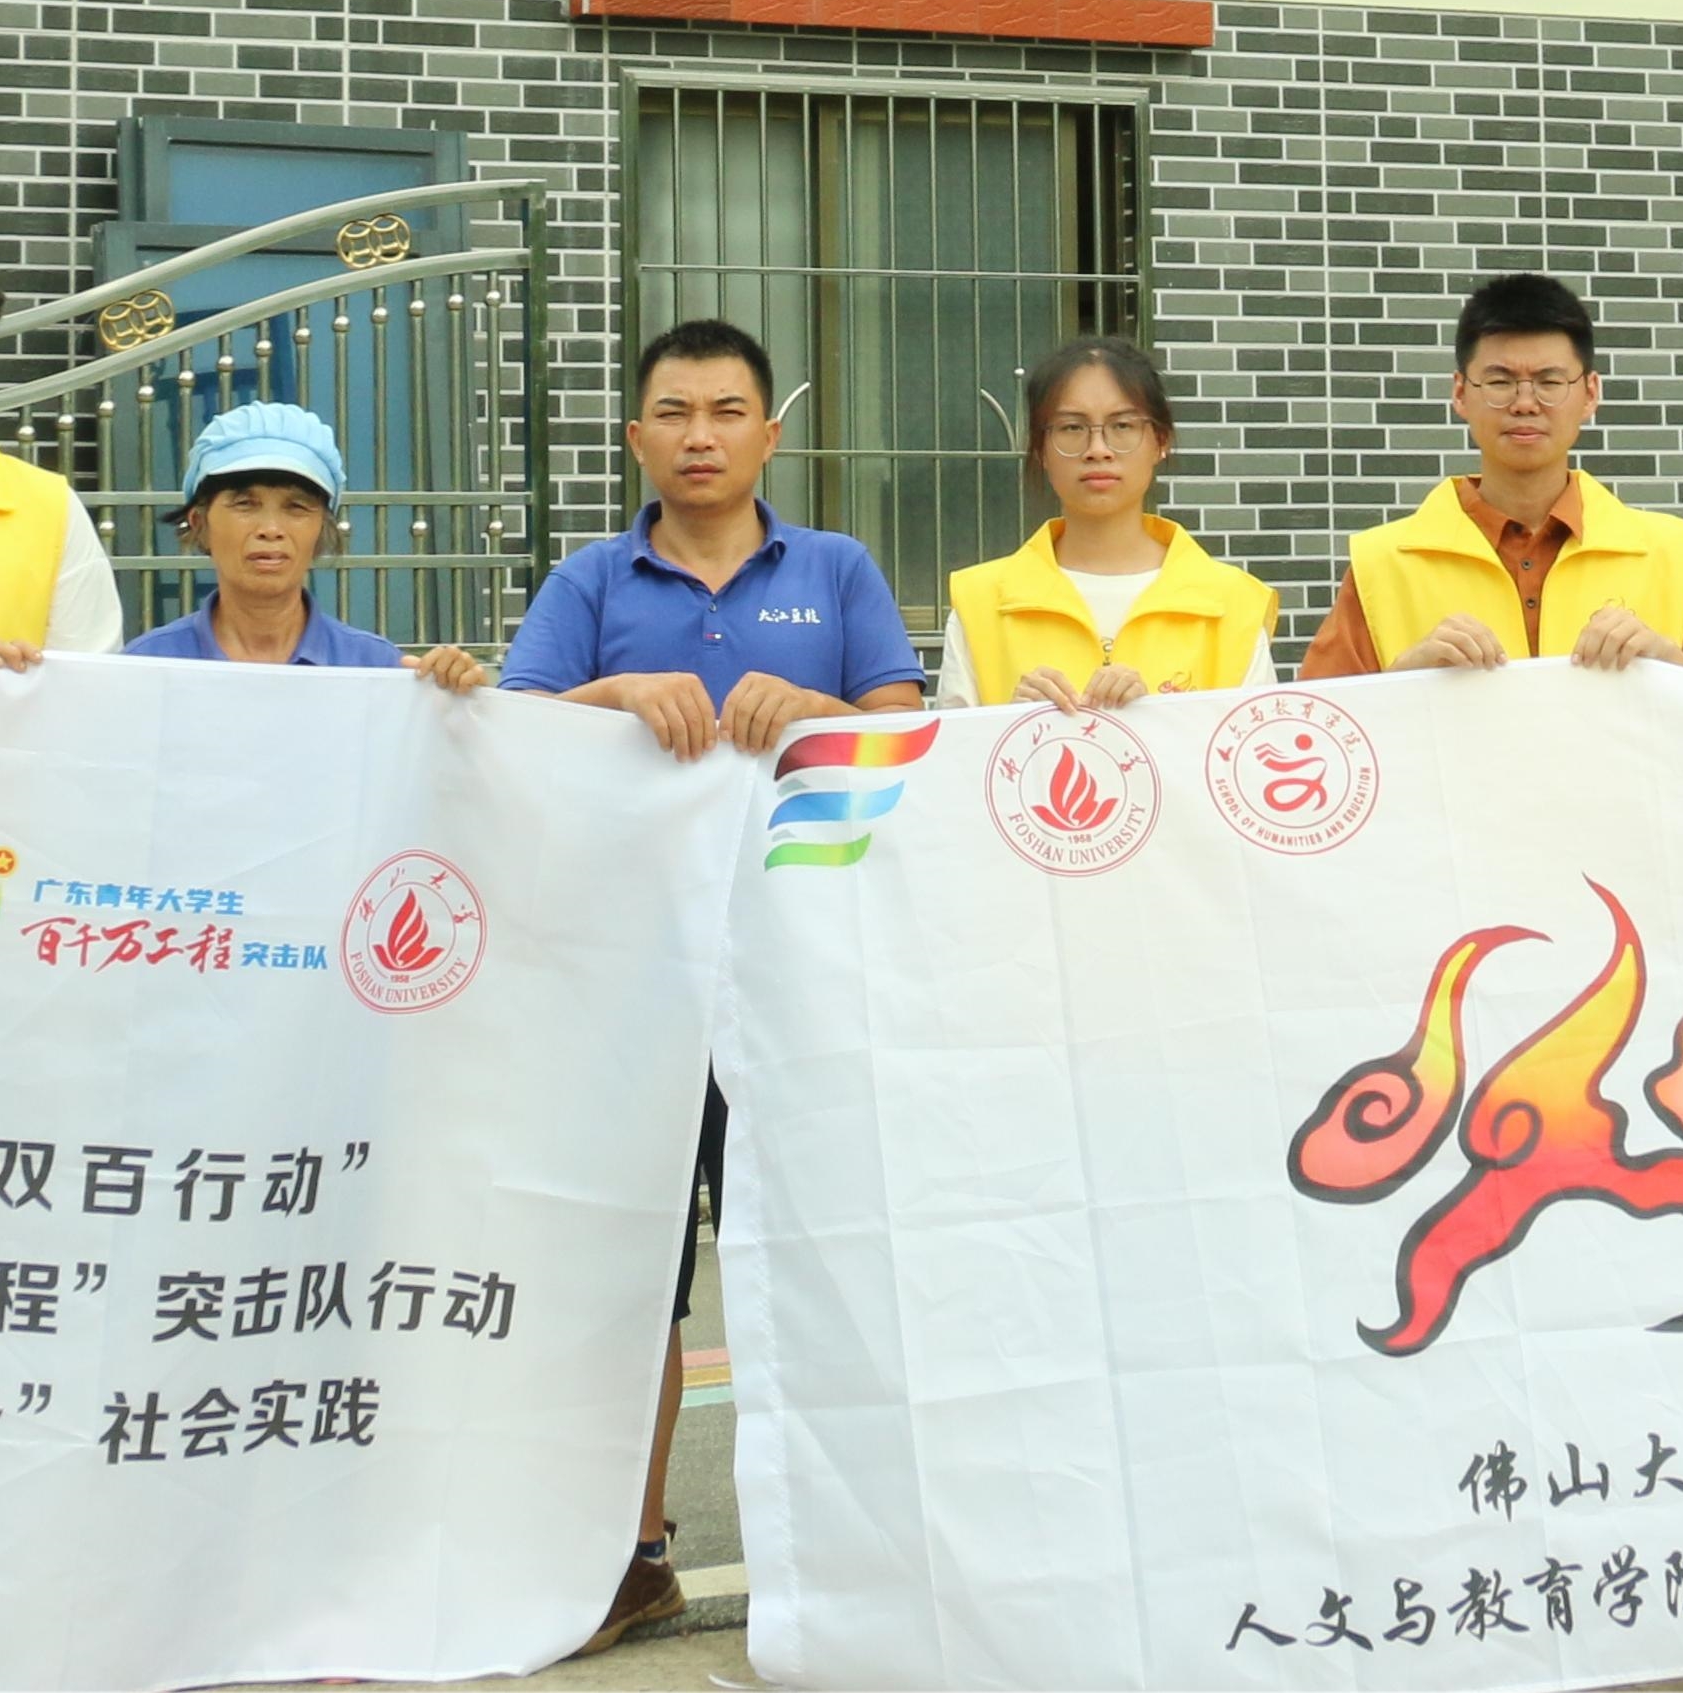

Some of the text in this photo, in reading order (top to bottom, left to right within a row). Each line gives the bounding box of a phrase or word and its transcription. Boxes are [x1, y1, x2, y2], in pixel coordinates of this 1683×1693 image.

[1008, 802, 1147, 866] FOSHAN UNIVERSITY
[1215, 766, 1372, 847] SCHOOL OF HUMANITIES AND EDUCATION
[33, 879, 245, 916] 广东青年大学生
[349, 951, 469, 1004] FOSHAN UNIVERSITY
